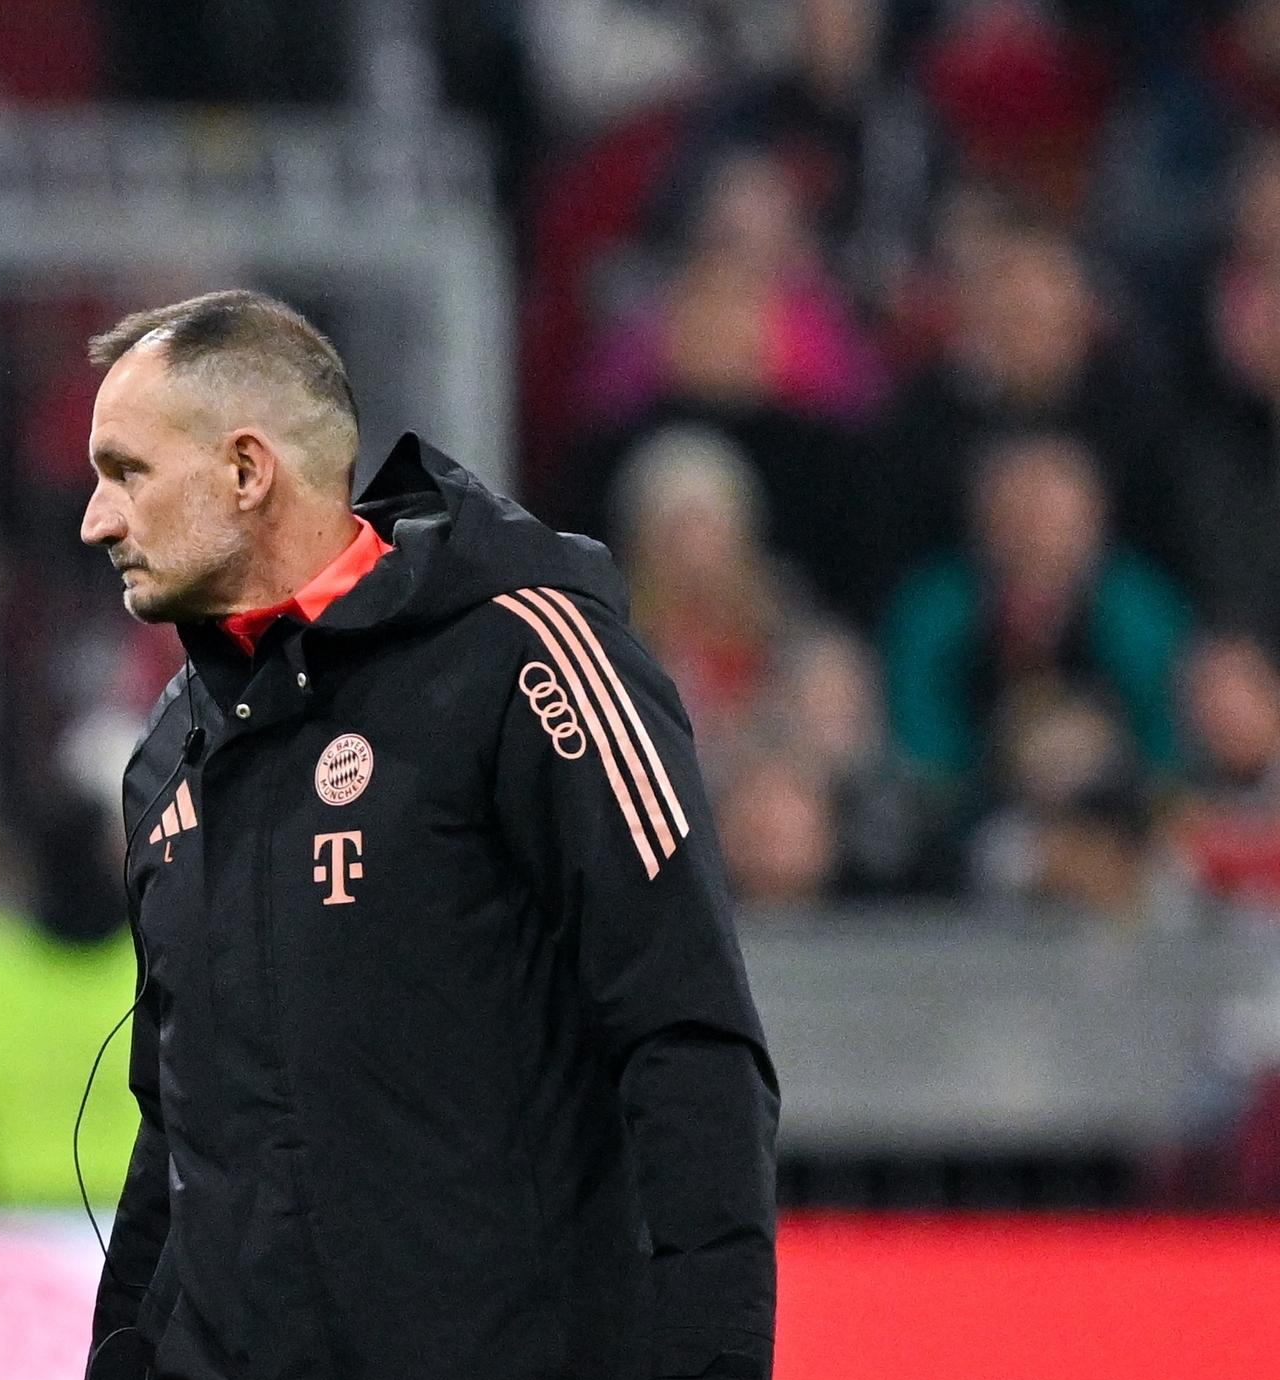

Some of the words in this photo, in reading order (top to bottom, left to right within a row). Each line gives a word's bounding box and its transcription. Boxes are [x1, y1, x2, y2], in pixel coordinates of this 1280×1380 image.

[336, 740, 368, 762] BAYERN
[164, 841, 173, 862] L
[313, 830, 363, 906] T
